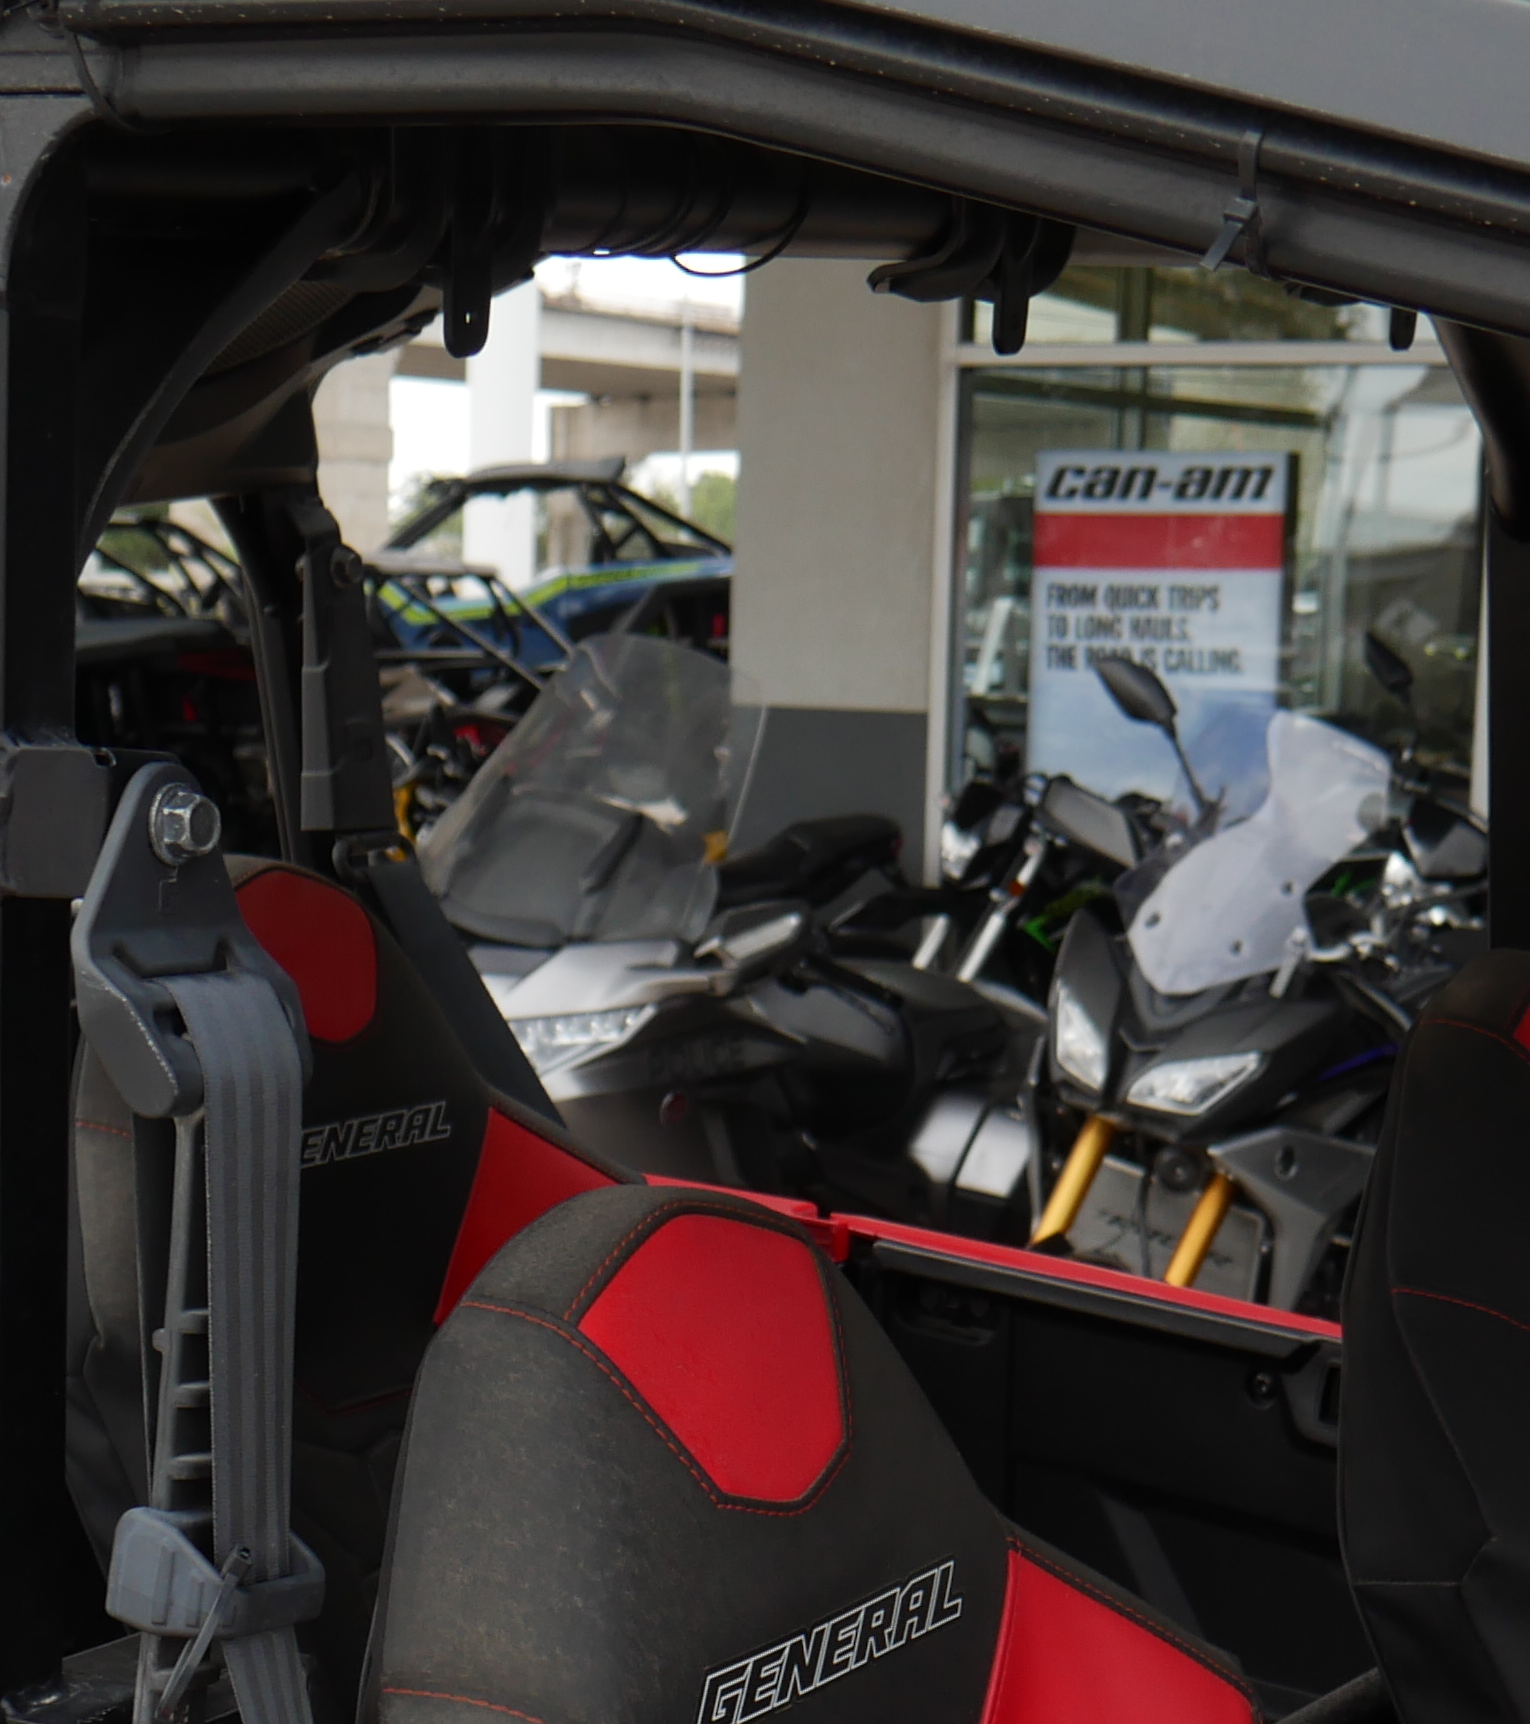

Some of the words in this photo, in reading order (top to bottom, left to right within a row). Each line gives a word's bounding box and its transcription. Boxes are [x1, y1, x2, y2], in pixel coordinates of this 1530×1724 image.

[1044, 464, 1274, 500] can-am
[1046, 583, 1098, 608] FROM
[1105, 584, 1159, 612] QUICK
[1168, 585, 1220, 612] TRIPS
[1047, 613, 1069, 640] TO
[1074, 613, 1124, 640] LONG
[1046, 643, 1076, 669] THE
[300, 1100, 452, 1169] ENERAL
